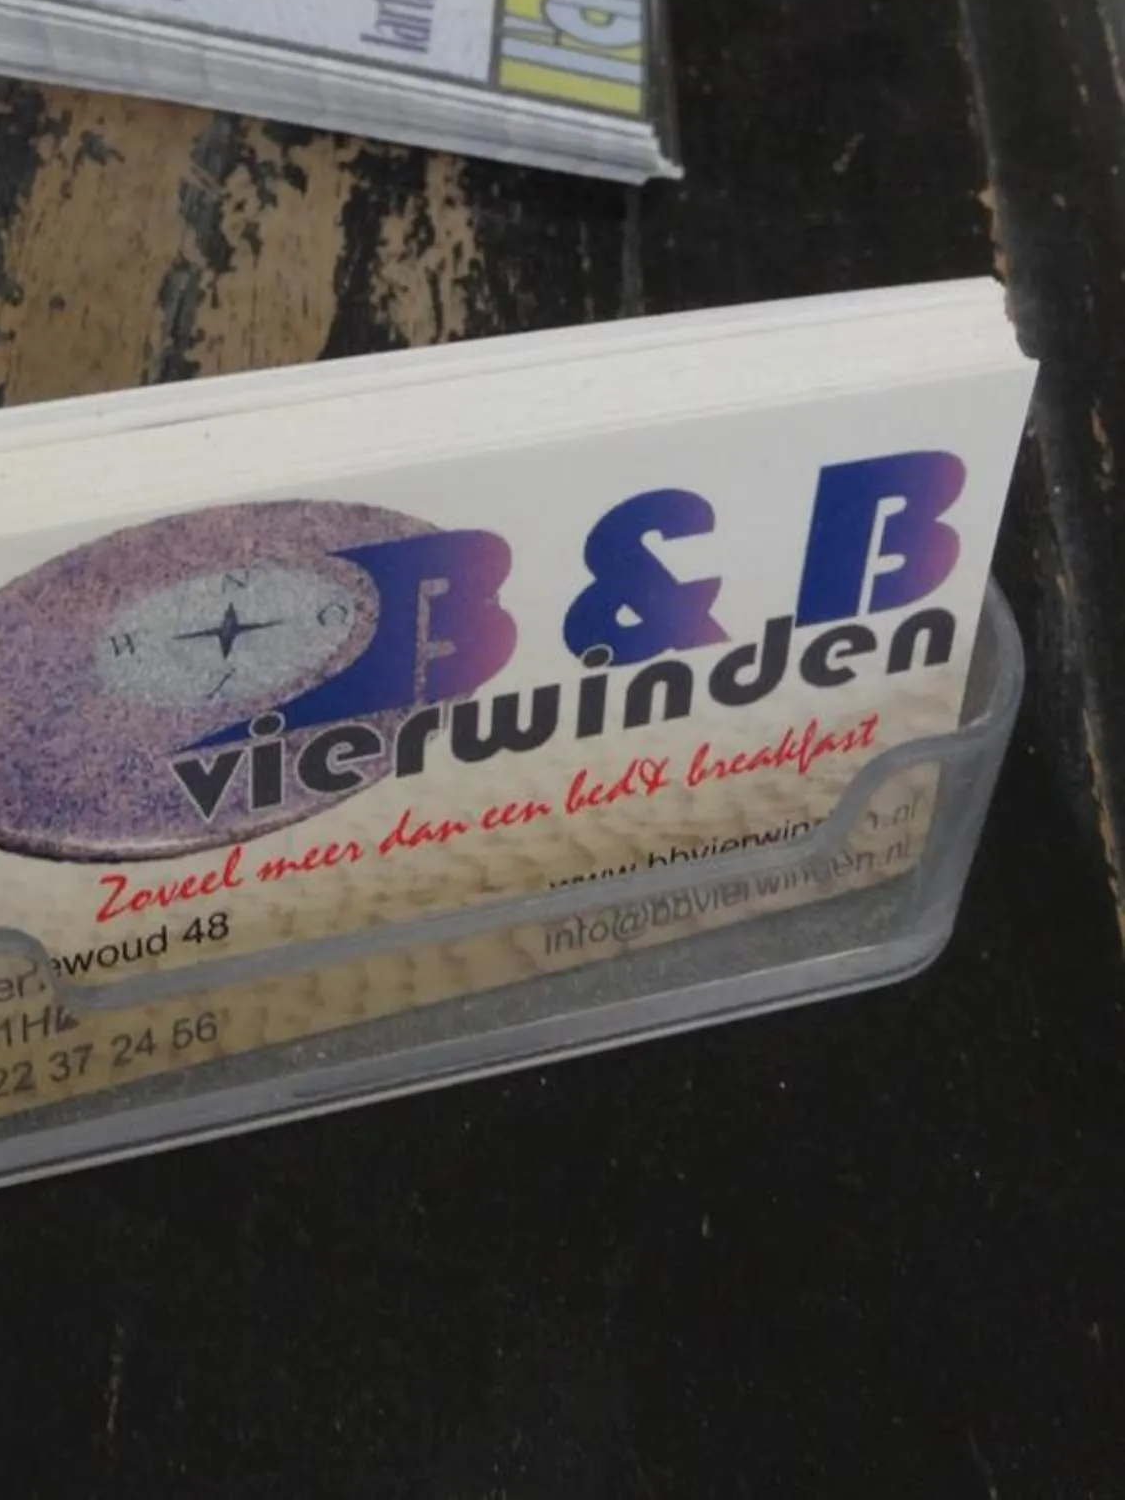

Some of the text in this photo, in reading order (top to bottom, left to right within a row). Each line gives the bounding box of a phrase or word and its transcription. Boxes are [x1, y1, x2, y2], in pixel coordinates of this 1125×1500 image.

[563, 488, 731, 666] &
[795, 450, 967, 628] B
[96, 845, 244, 924] Zoveel
[256, 836, 364, 884] meer
[378, 808, 467, 856] dan
[479, 799, 552, 831] een
[687, 713, 880, 790] breakfast
[172, 607, 958, 822] vierwinden
[180, 911, 231, 944] 48
[48, 1042, 95, 1084] 37
[110, 1028, 158, 1068] 24
[172, 1011, 220, 1050] 56
